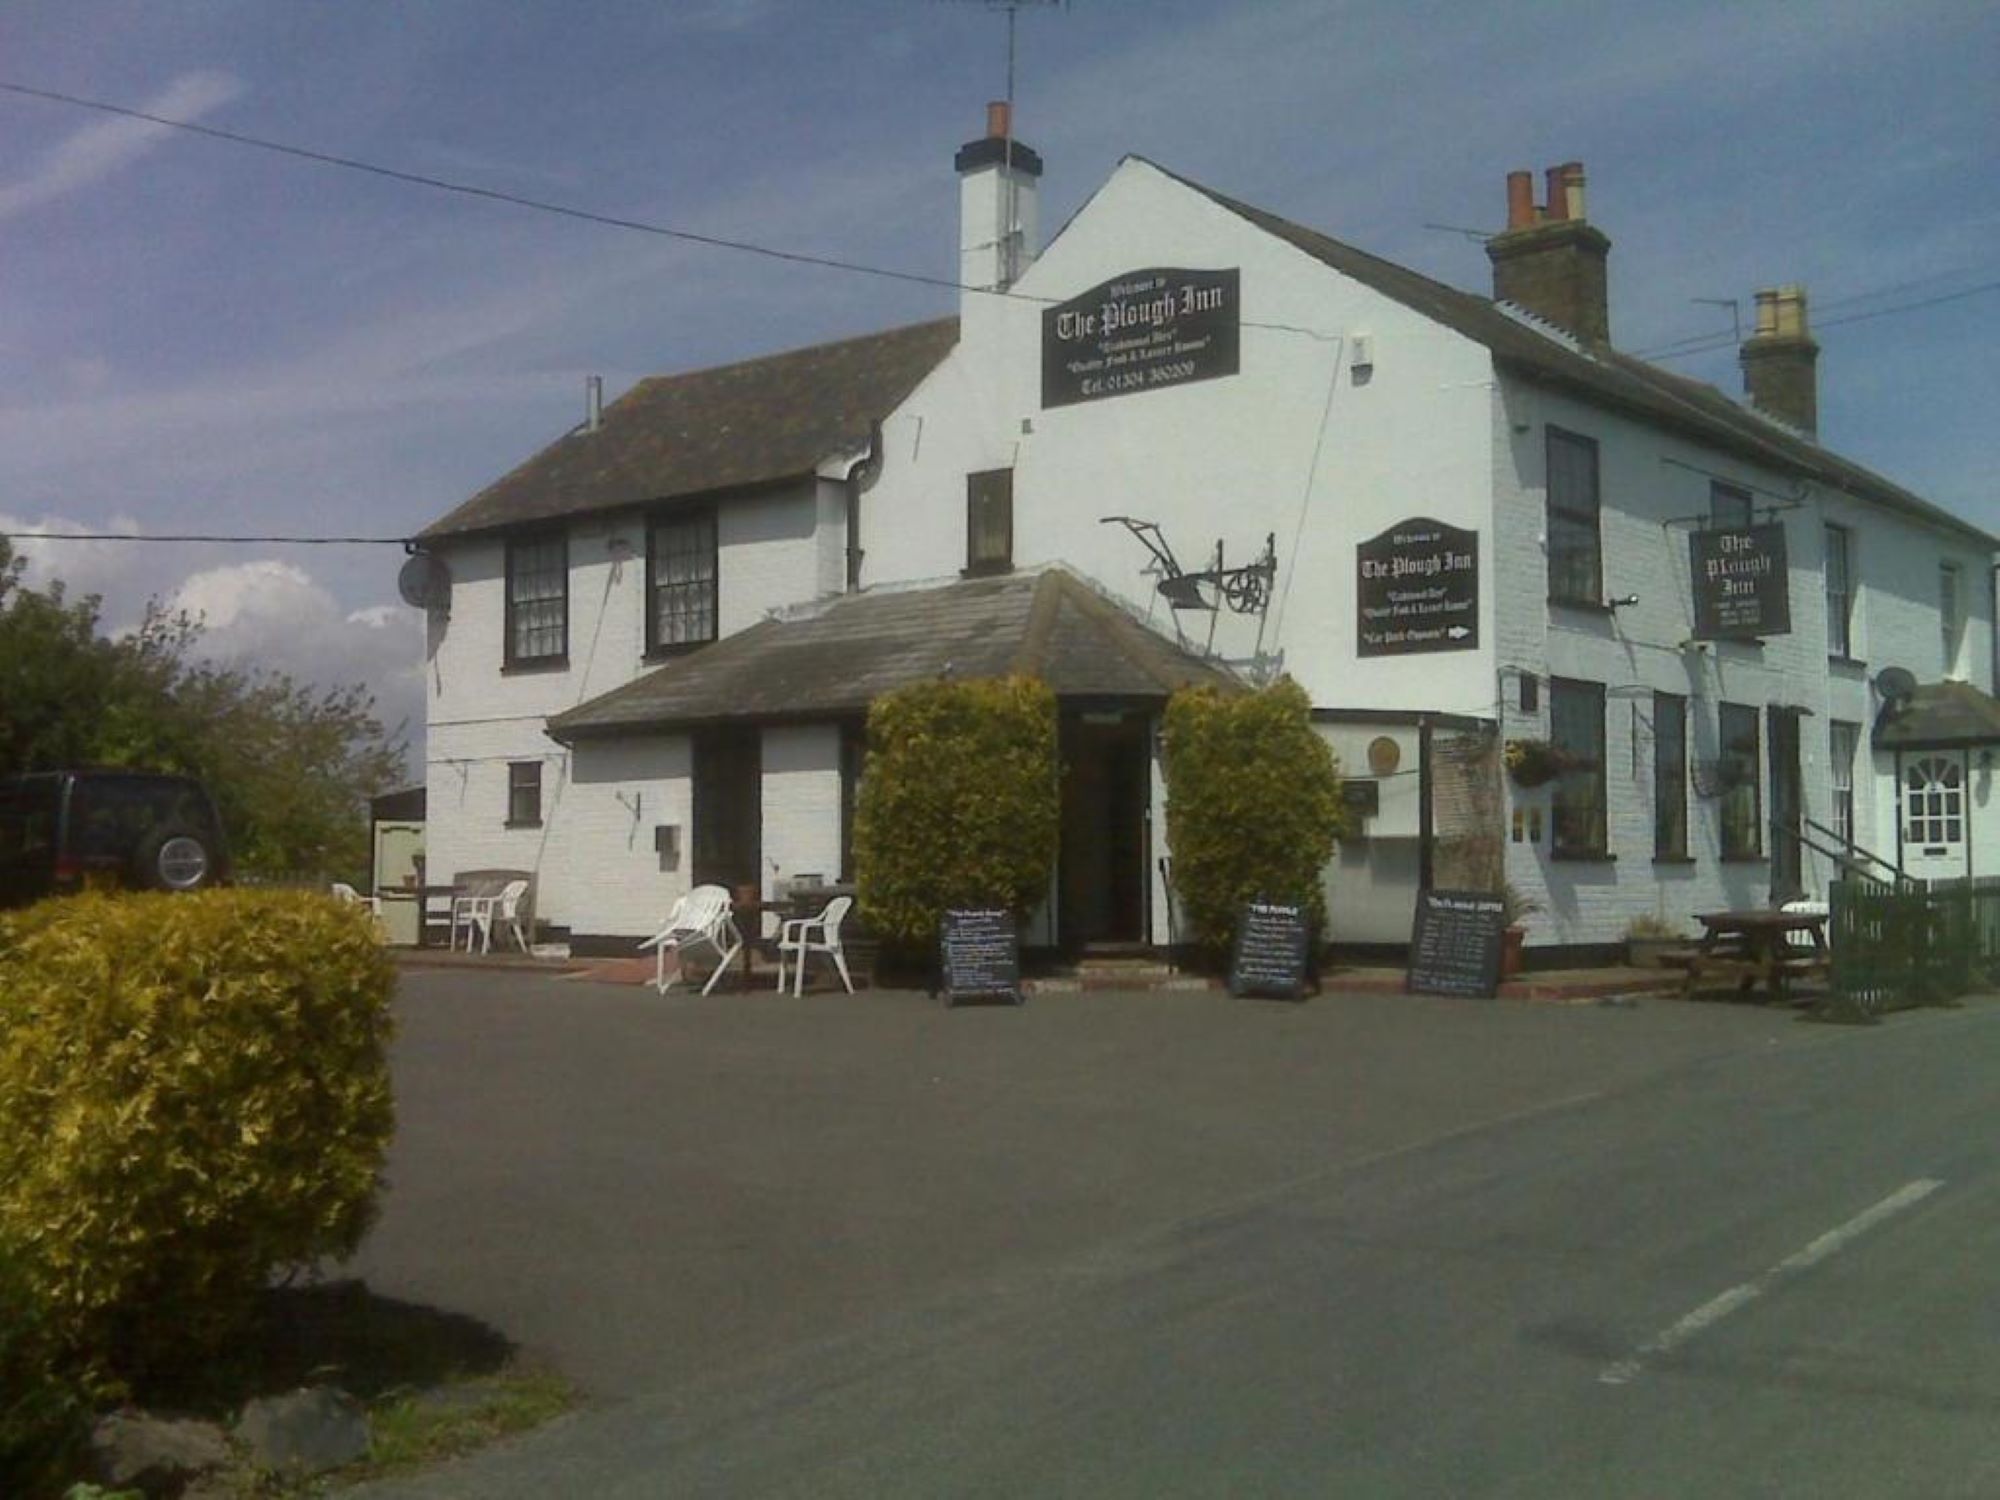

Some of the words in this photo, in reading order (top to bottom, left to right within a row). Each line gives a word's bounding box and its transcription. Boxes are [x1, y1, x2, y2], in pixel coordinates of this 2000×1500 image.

[1056, 311, 1096, 341] The
[1100, 289, 1176, 337] Plough
[1179, 285, 1224, 315] Inn
[1721, 534, 1753, 556] The
[1362, 560, 1389, 578] The
[1391, 553, 1441, 579] Plough
[1443, 551, 1471, 571] Inn
